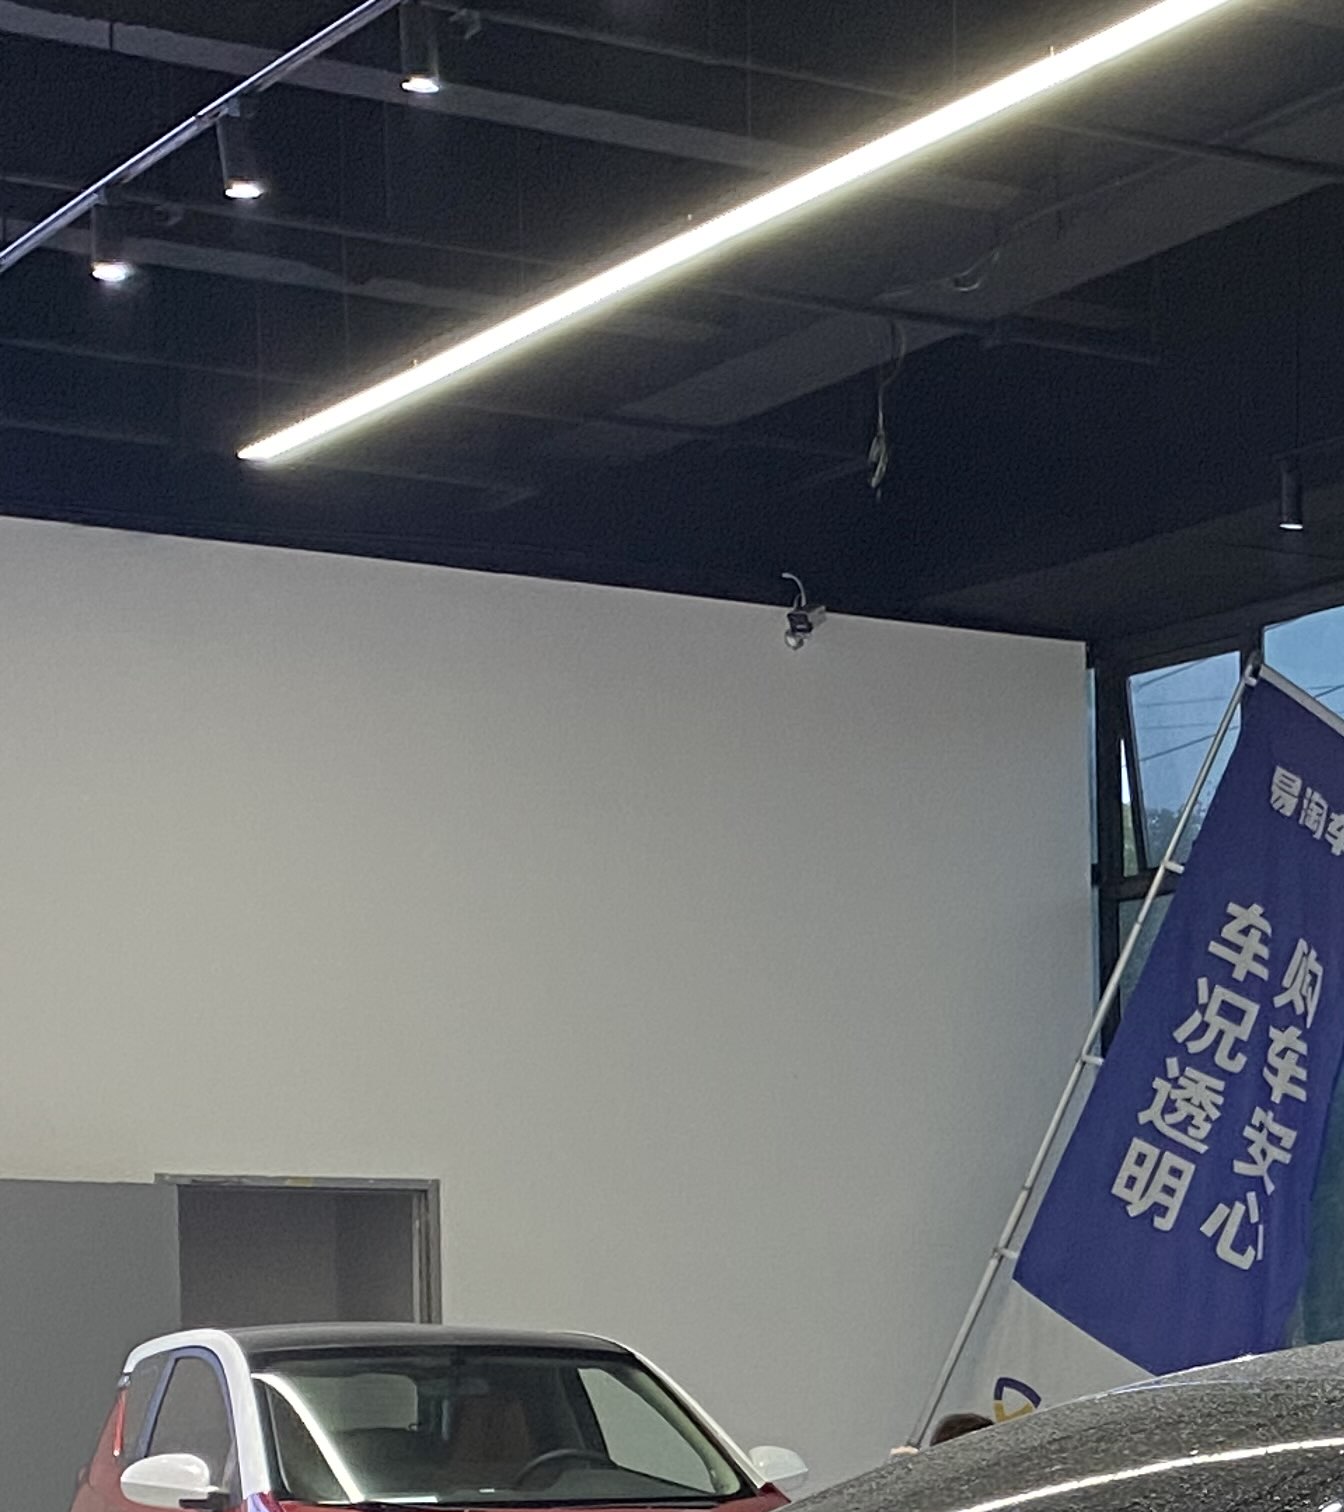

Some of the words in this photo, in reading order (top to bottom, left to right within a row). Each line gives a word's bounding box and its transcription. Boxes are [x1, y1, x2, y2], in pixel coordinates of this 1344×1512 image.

[1111, 901, 1274, 1233] 车况透明
[1200, 938, 1325, 1271] 购车安心
